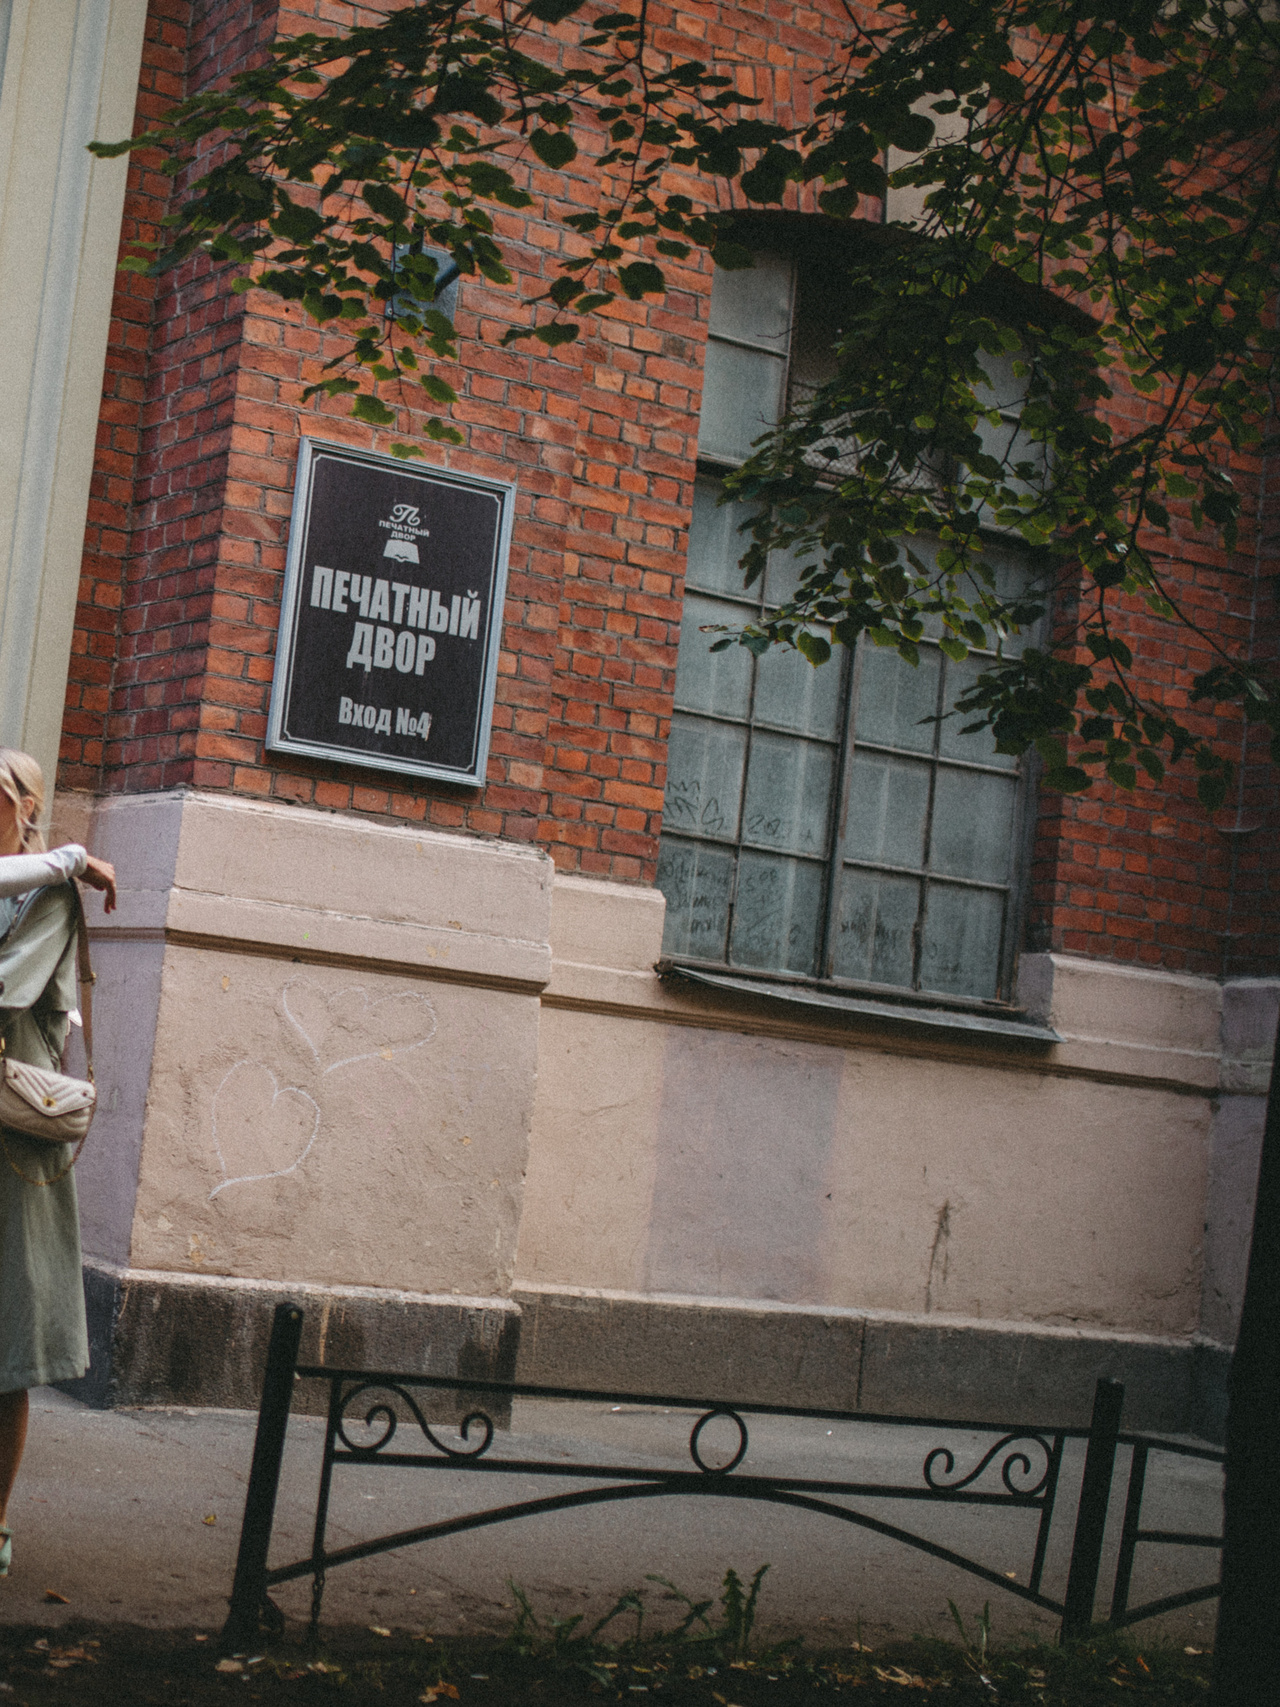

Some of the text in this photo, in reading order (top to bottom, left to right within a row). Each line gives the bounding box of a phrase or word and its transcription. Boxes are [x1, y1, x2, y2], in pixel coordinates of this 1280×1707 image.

[378, 519, 430, 538] ПЕЧАТНЫЙ
[390, 530, 416, 541] ДВОР
[310, 565, 482, 640] ПЕЧАТНЫЙ
[346, 621, 436, 676] ДВОР
[338, 696, 431, 740] Вход №4
